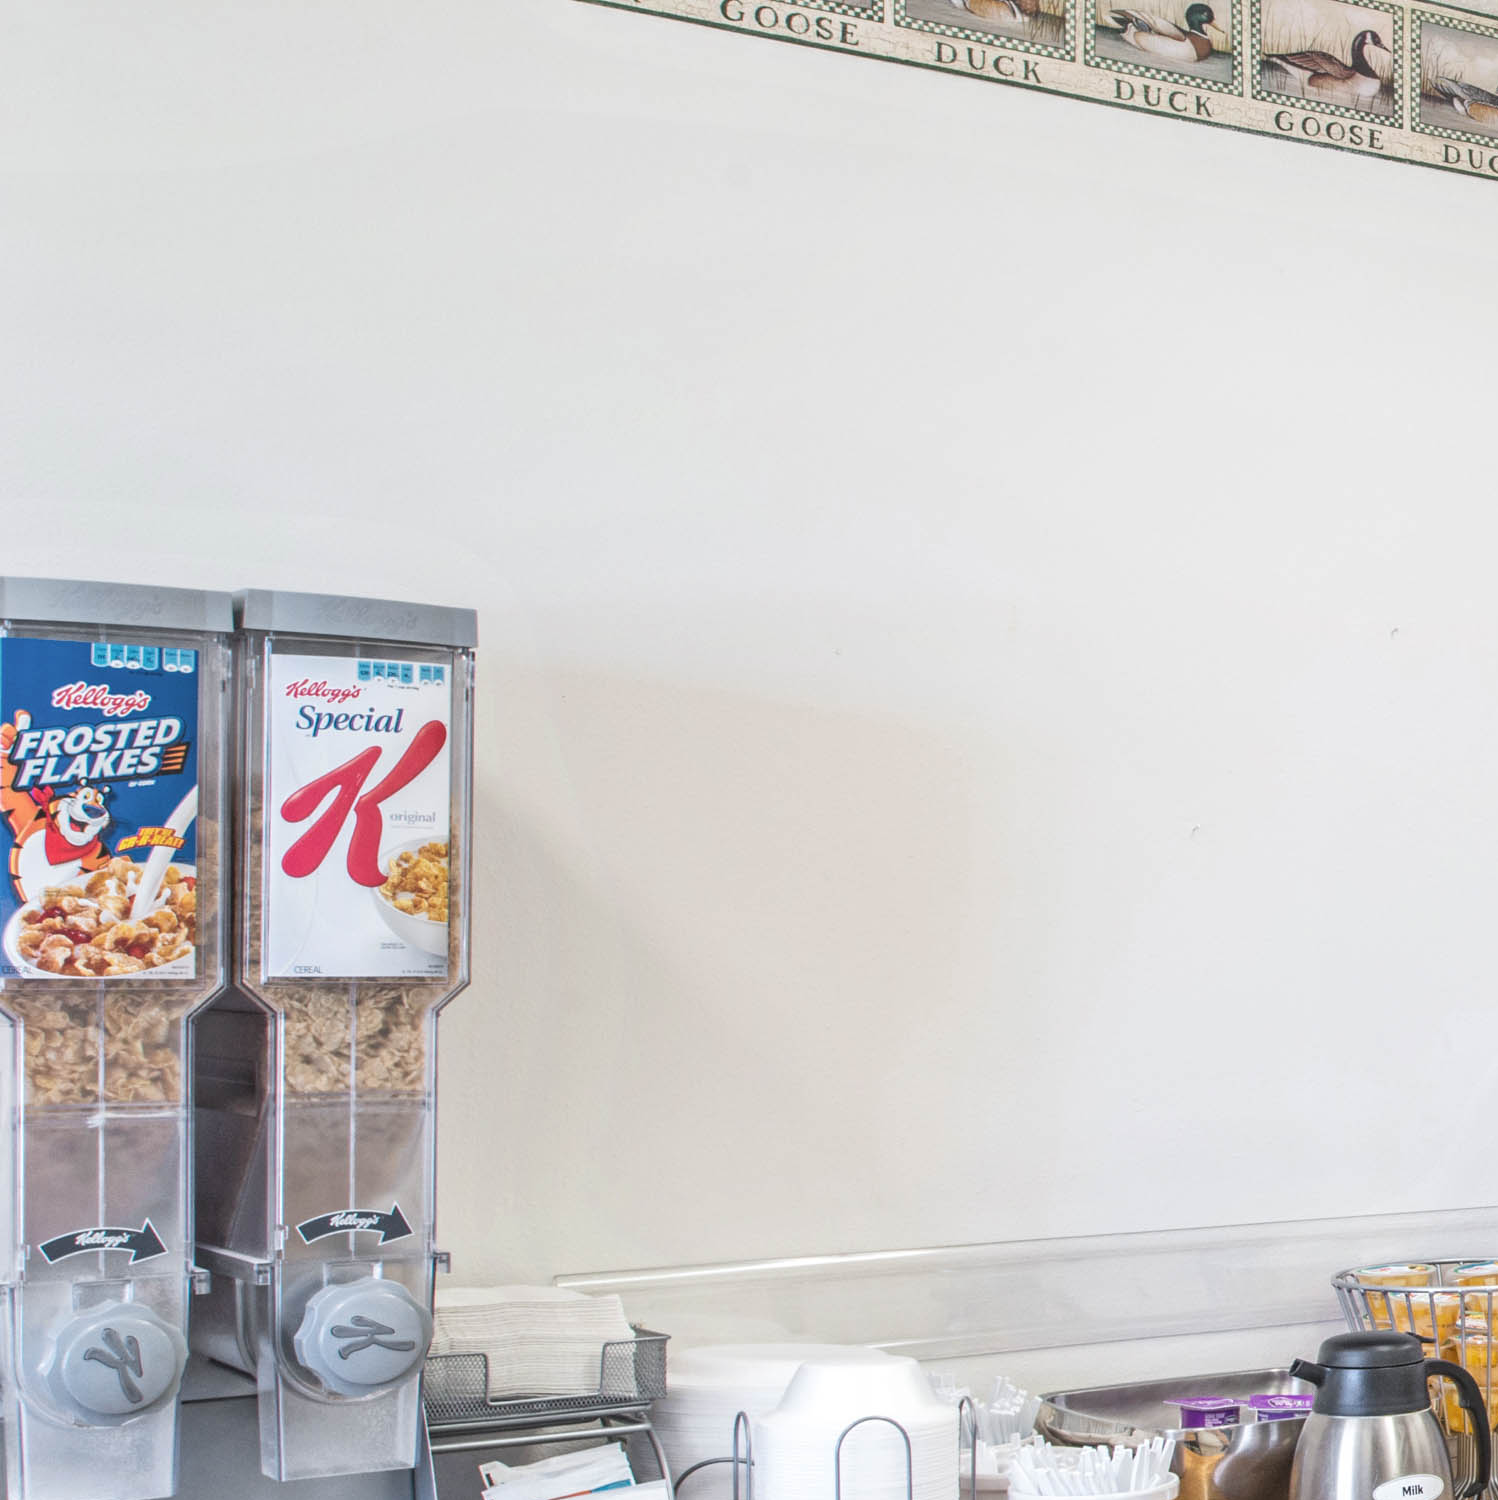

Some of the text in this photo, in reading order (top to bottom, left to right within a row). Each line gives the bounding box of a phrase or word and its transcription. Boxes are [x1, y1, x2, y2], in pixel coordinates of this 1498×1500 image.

[719, 0, 860, 46] GOOSE
[934, 41, 1043, 84] DUCK
[1113, 78, 1215, 118] DUCK
[1274, 110, 1385, 151] GOOSE
[53, 682, 151, 716] Kellogg's
[285, 679, 362, 704] Kellogg's
[296, 705, 404, 738] Special
[14, 718, 181, 760] FROSTED
[17, 746, 161, 786] FLAKES
[281, 720, 447, 887] K
[390, 810, 436, 825] original
[330, 1213, 379, 1228] Kellogg's
[75, 1231, 129, 1248] Kellogg's
[1402, 1485, 1424, 1497] Milk
